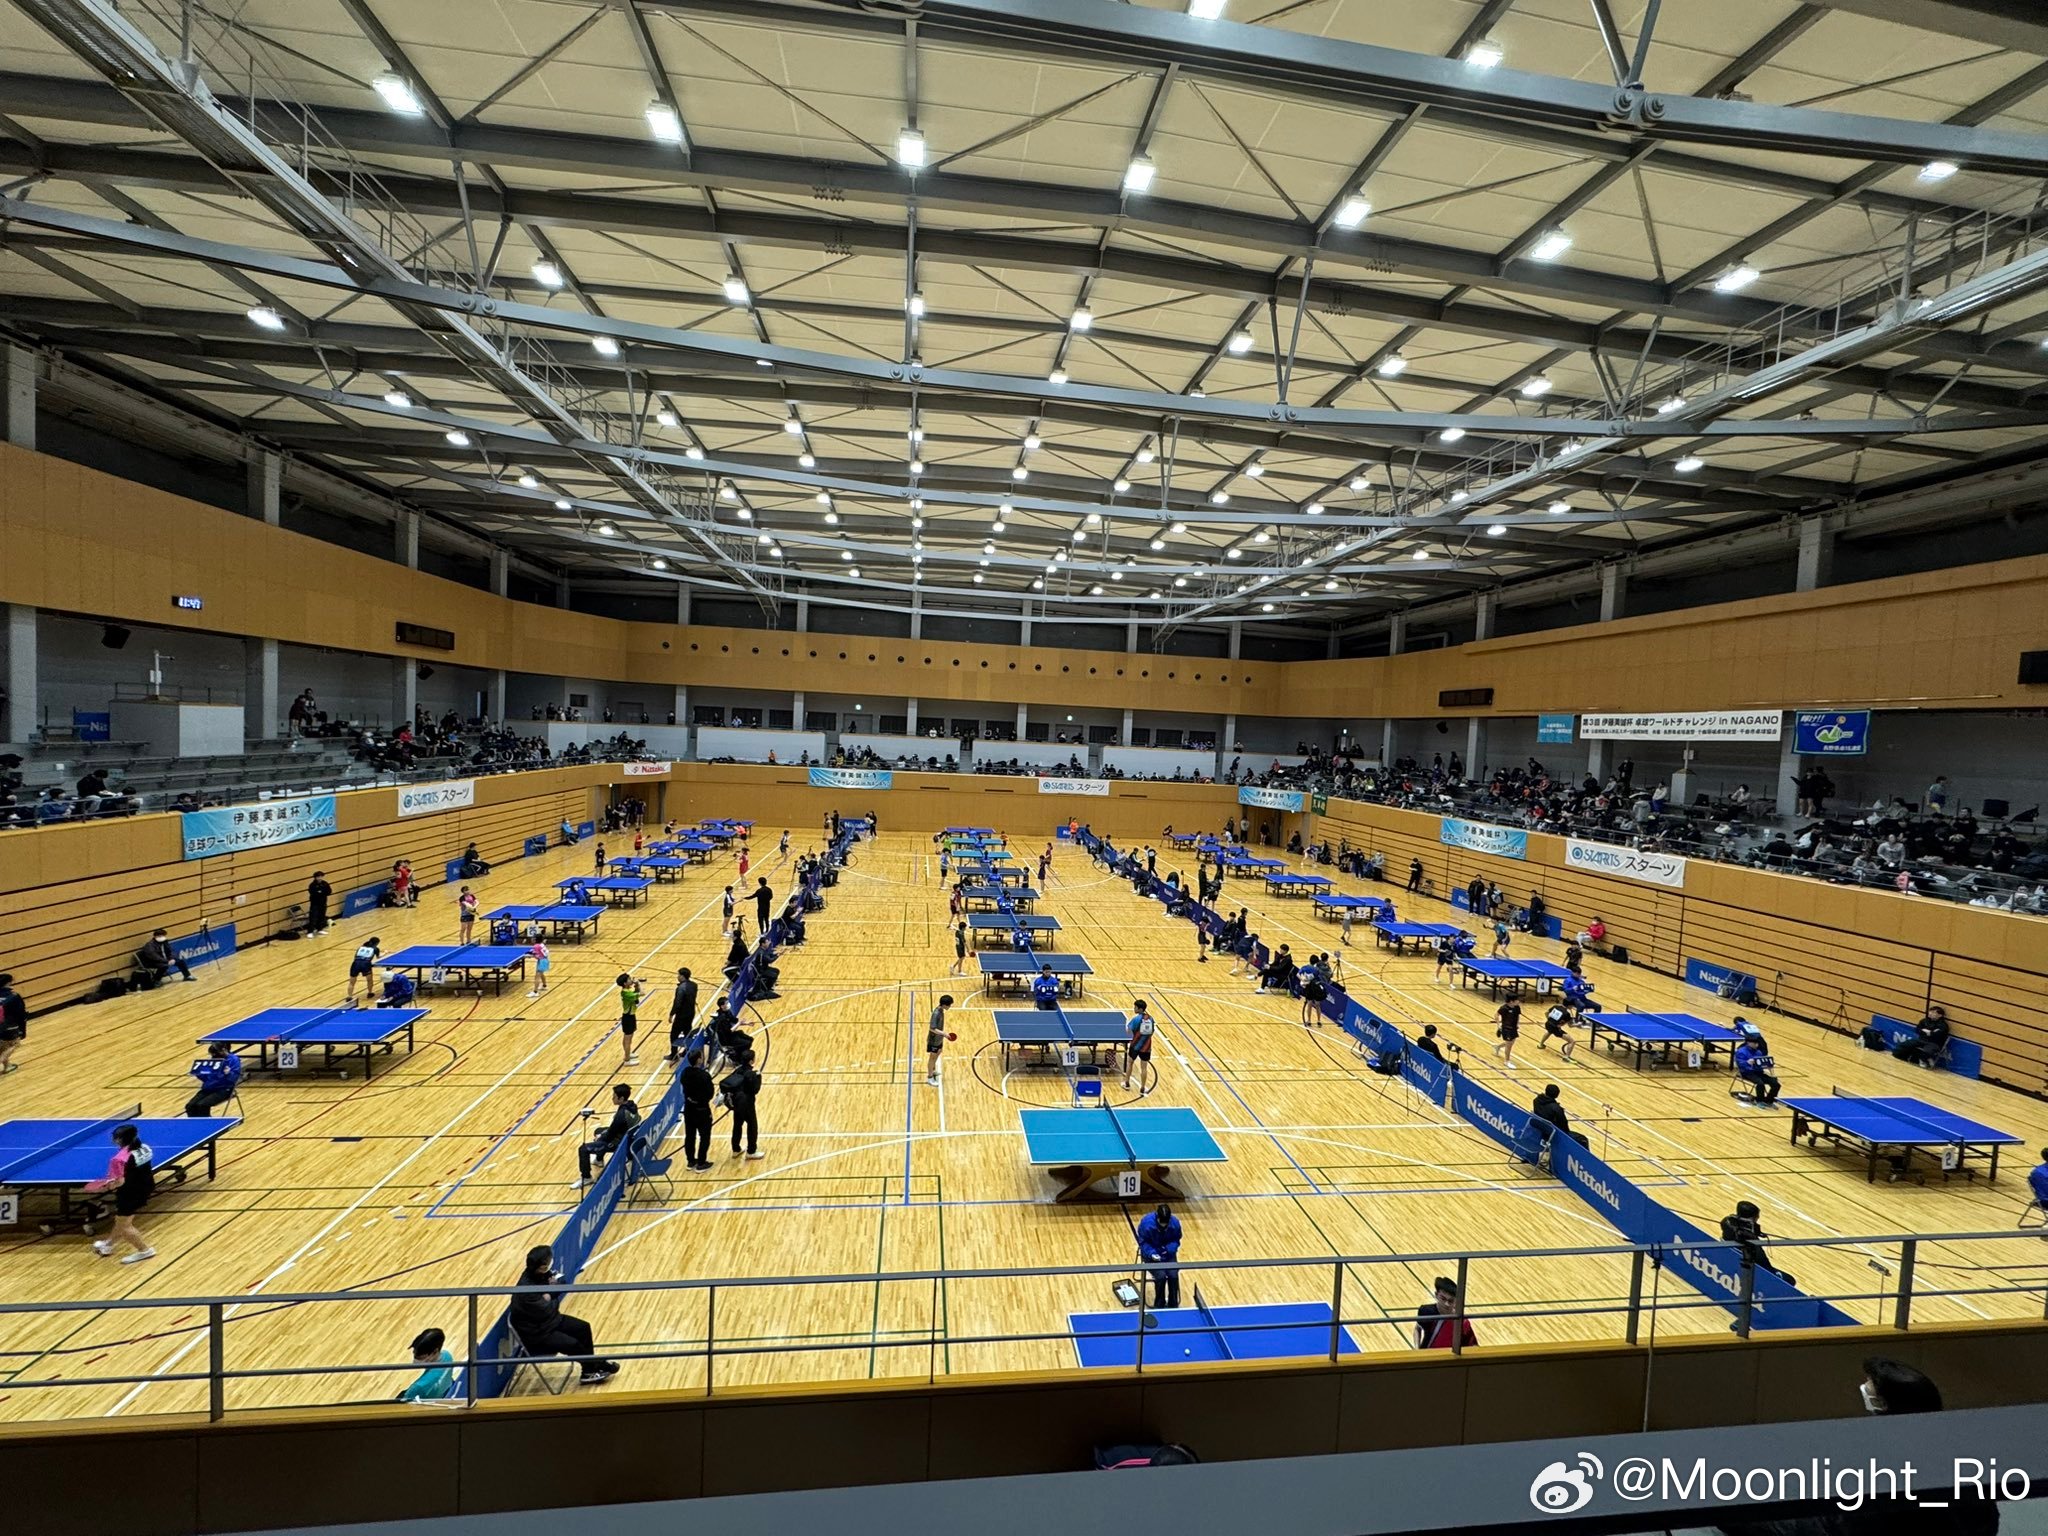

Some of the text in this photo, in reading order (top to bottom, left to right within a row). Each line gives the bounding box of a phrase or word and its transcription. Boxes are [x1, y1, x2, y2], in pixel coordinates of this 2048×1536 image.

[1635, 717, 1716, 726] 卓球ワールドチャレンジ
[1719, 716, 1728, 725] in
[1730, 715, 1779, 725] NAGANO
[441, 787, 470, 803] スターツ
[1077, 783, 1105, 792] スターツ
[233, 806, 300, 825] 伊藤美誠杯
[187, 826, 283, 852] 卓球ワールドチャレンジ
[1625, 856, 1676, 876] スターツ
[179, 940, 220, 960] Nittaku
[432, 970, 443, 982] 24
[281, 1052, 294, 1066] 23
[1066, 1051, 1076, 1063] 18
[1691, 1053, 1697, 1064] 3
[193, 1061, 201, 1070] 7
[213, 1061, 221, 1070] 5
[1466, 1094, 1516, 1139] Nittaku
[1945, 1151, 1952, 1167] 2
[1123, 1176, 1137, 1193] 19
[1567, 1154, 1620, 1211] Nittaku
[579, 1165, 623, 1249] Nittaku
